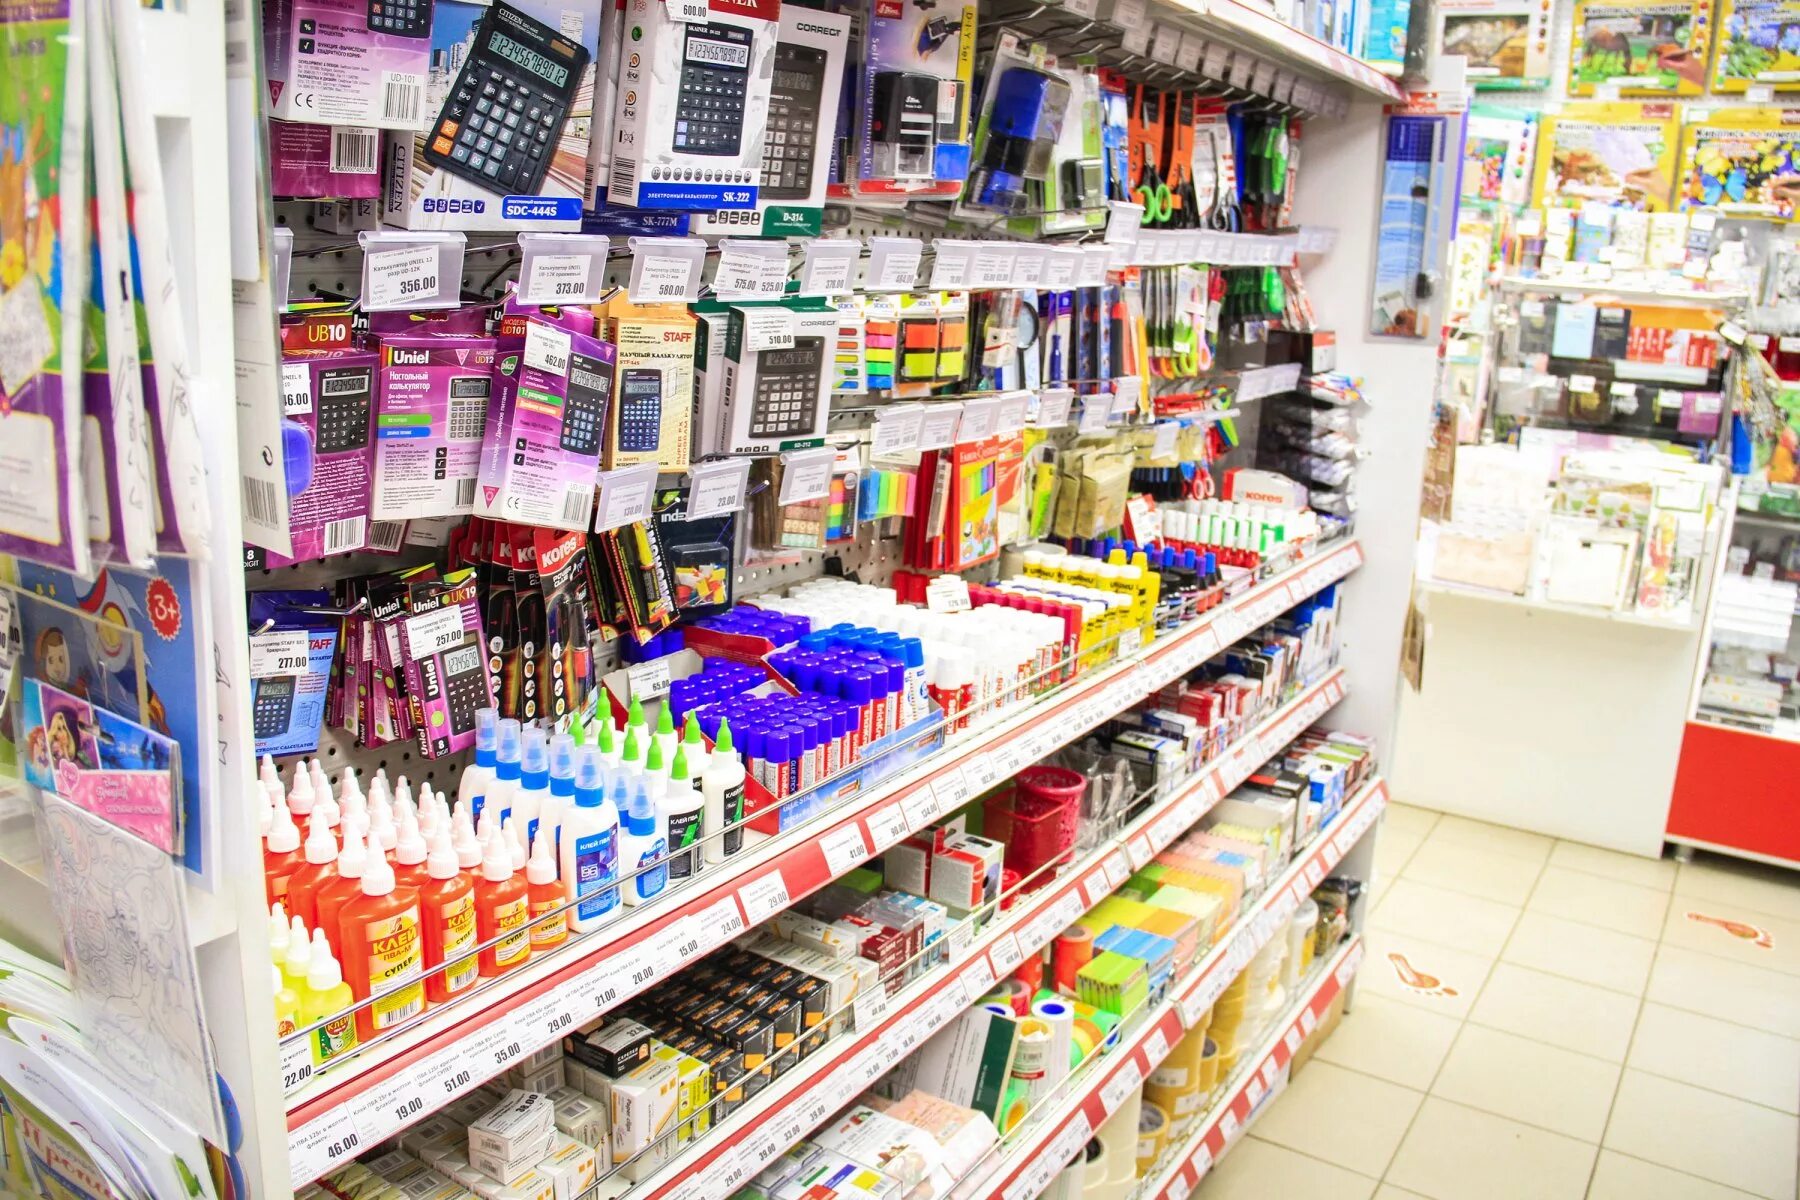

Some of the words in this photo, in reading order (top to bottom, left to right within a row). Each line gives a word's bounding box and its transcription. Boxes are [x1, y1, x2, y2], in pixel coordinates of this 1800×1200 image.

[499, 8, 522, 25] CITIZEN
[683, 5, 706, 17] 600.00
[797, 22, 841, 37] CORRECT
[390, 73, 415, 83] UD-101
[395, 145, 406, 212] CITIZEN
[723, 191, 749, 202] SK-222
[506, 205, 557, 216] SDC-444S
[783, 212, 804, 222] D-314
[642, 216, 678, 227] SK-777M
[373, 262, 409, 272] Калькулятор
[400, 276, 436, 294] 356.00
[556, 283, 584, 295] 373.00
[659, 284, 685, 296] 580.00
[734, 279, 756, 291] 575.00
[502, 326, 526, 335] UD101
[504, 318, 527, 326] МОДЕЛЬ
[308, 323, 346, 343] UB10
[663, 331, 692, 343] STAFF
[769, 335, 792, 345] 510.00
[393, 350, 430, 364] Uniel
[475, 355, 495, 364] UD12
[544, 354, 566, 370] 462.00
[389, 370, 429, 381] Настольный
[388, 382, 431, 392] калькулятор
[1245, 490, 1283, 505] Kores
[247, 550, 255, 560] 8
[541, 537, 577, 568] Kores
[451, 587, 476, 603] UK19
[152, 594, 178, 621] 3+
[374, 598, 400, 618] Uniel
[413, 596, 439, 613] Uniel
[436, 630, 462, 647] 257.00
[278, 657, 307, 669] 277.00
[423, 659, 439, 697] Uniel
[411, 694, 423, 725] UK19
[417, 726, 429, 756] Uniel
[279, 742, 314, 751] CALCULATOR
[438, 738, 444, 748] 8
[671, 816, 687, 825] КЛЕЙ
[580, 840, 599, 850] КЛЕЙ
[599, 837, 611, 846] ПВА
[768, 890, 788, 909] 29.00
[721, 916, 741, 936] 24.00
[373, 925, 417, 955] КЛЕЙ
[679, 939, 698, 958] 15.00
[383, 945, 412, 961] ПВА-М
[384, 956, 413, 978] СУПЕР
[632, 965, 654, 986] 20.00
[594, 987, 617, 1008] 21.00
[547, 1012, 573, 1034] 29.00
[494, 1042, 521, 1065] 35.00
[417, 1070, 428, 1081] ПВА
[439, 1053, 460, 1069] красный
[437, 1064, 453, 1077] СУПЕР
[284, 1064, 312, 1089] 22.00
[444, 1070, 471, 1094] 51.00
[353, 1105, 366, 1116] Клей
[365, 1099, 378, 1110] ПВА
[391, 1079, 412, 1094] желтом
[515, 1093, 539, 1113] 38.00
[394, 1096, 423, 1121] 19.00
[295, 1136, 308, 1149] ПВА
[308, 1129, 322, 1141] 125г
[326, 1114, 348, 1130] желтом
[783, 1124, 801, 1142] 33.00
[327, 1133, 359, 1159] 46.00
[758, 1143, 777, 1162] 39.00
[724, 1168, 743, 1188] 29.00
